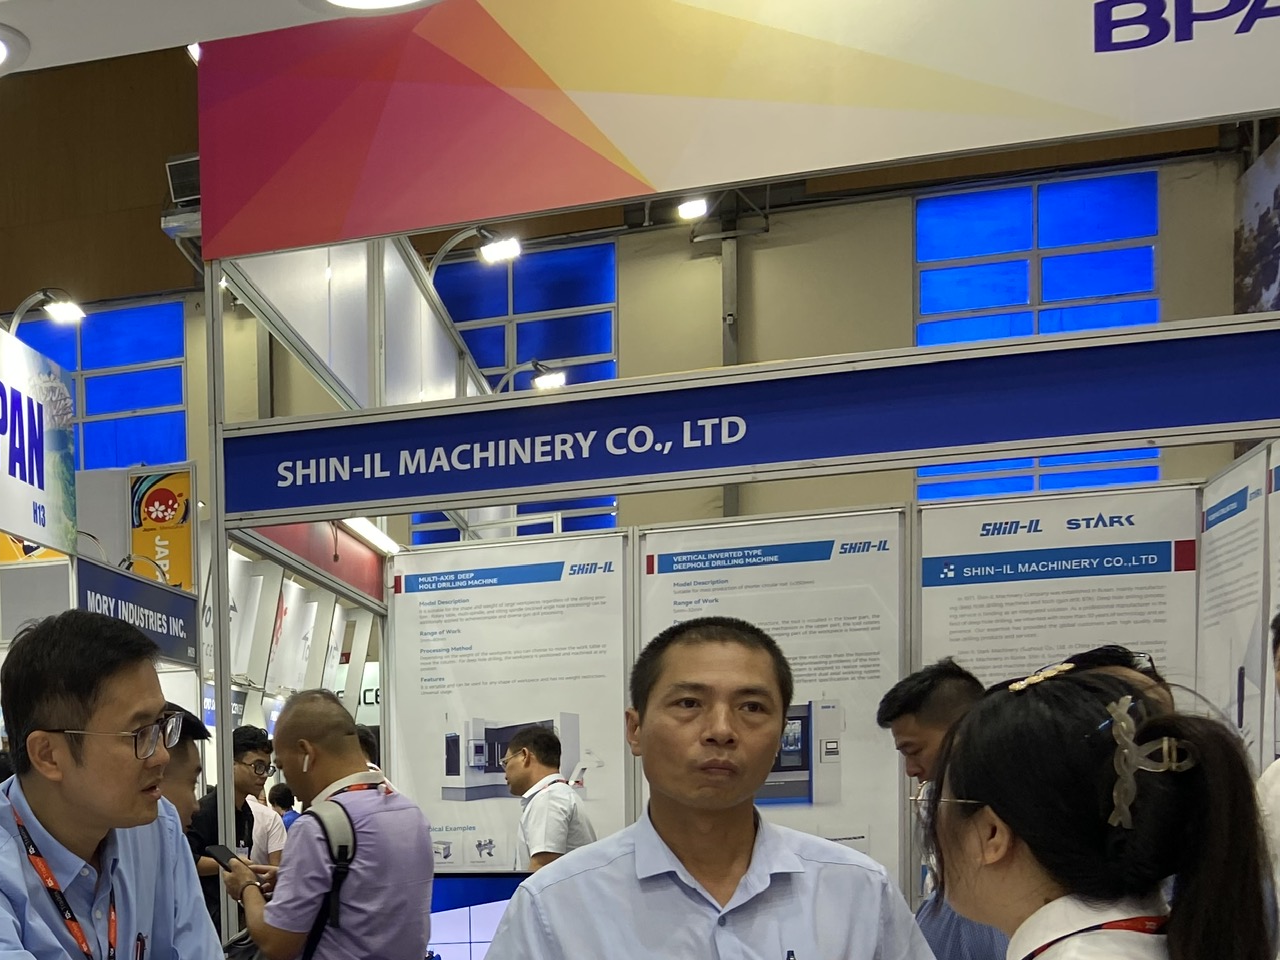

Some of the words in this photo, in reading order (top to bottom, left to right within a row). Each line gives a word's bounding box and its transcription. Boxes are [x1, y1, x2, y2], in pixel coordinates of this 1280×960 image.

[276, 453, 391, 489] SHIN-IL
[398, 429, 598, 477] MACHINERY
[605, 424, 673, 457] CO.,
[682, 415, 748, 448] LTD
[31, 500, 47, 529] H13
[672, 553, 707, 563] VERTICAL
[707, 550, 743, 560] INVERTED
[744, 549, 763, 557] TYPE
[672, 561, 710, 571] DEEPHOLE
[711, 557, 745, 567] DRILLING
[745, 555, 779, 565] MACHINE
[962, 564, 1015, 577] SHIN-IL
[1017, 557, 1100, 574] MACHINERY
[418, 574, 455, 583] MULTI-AXIS
[437, 580, 467, 589] DRILLING
[467, 578, 498, 586] MACHINE
[86, 590, 116, 618] MORY
[117, 599, 168, 634] INDUSTRIES
[169, 616, 187, 639] INC.
[445, 824, 476, 832] Examples
